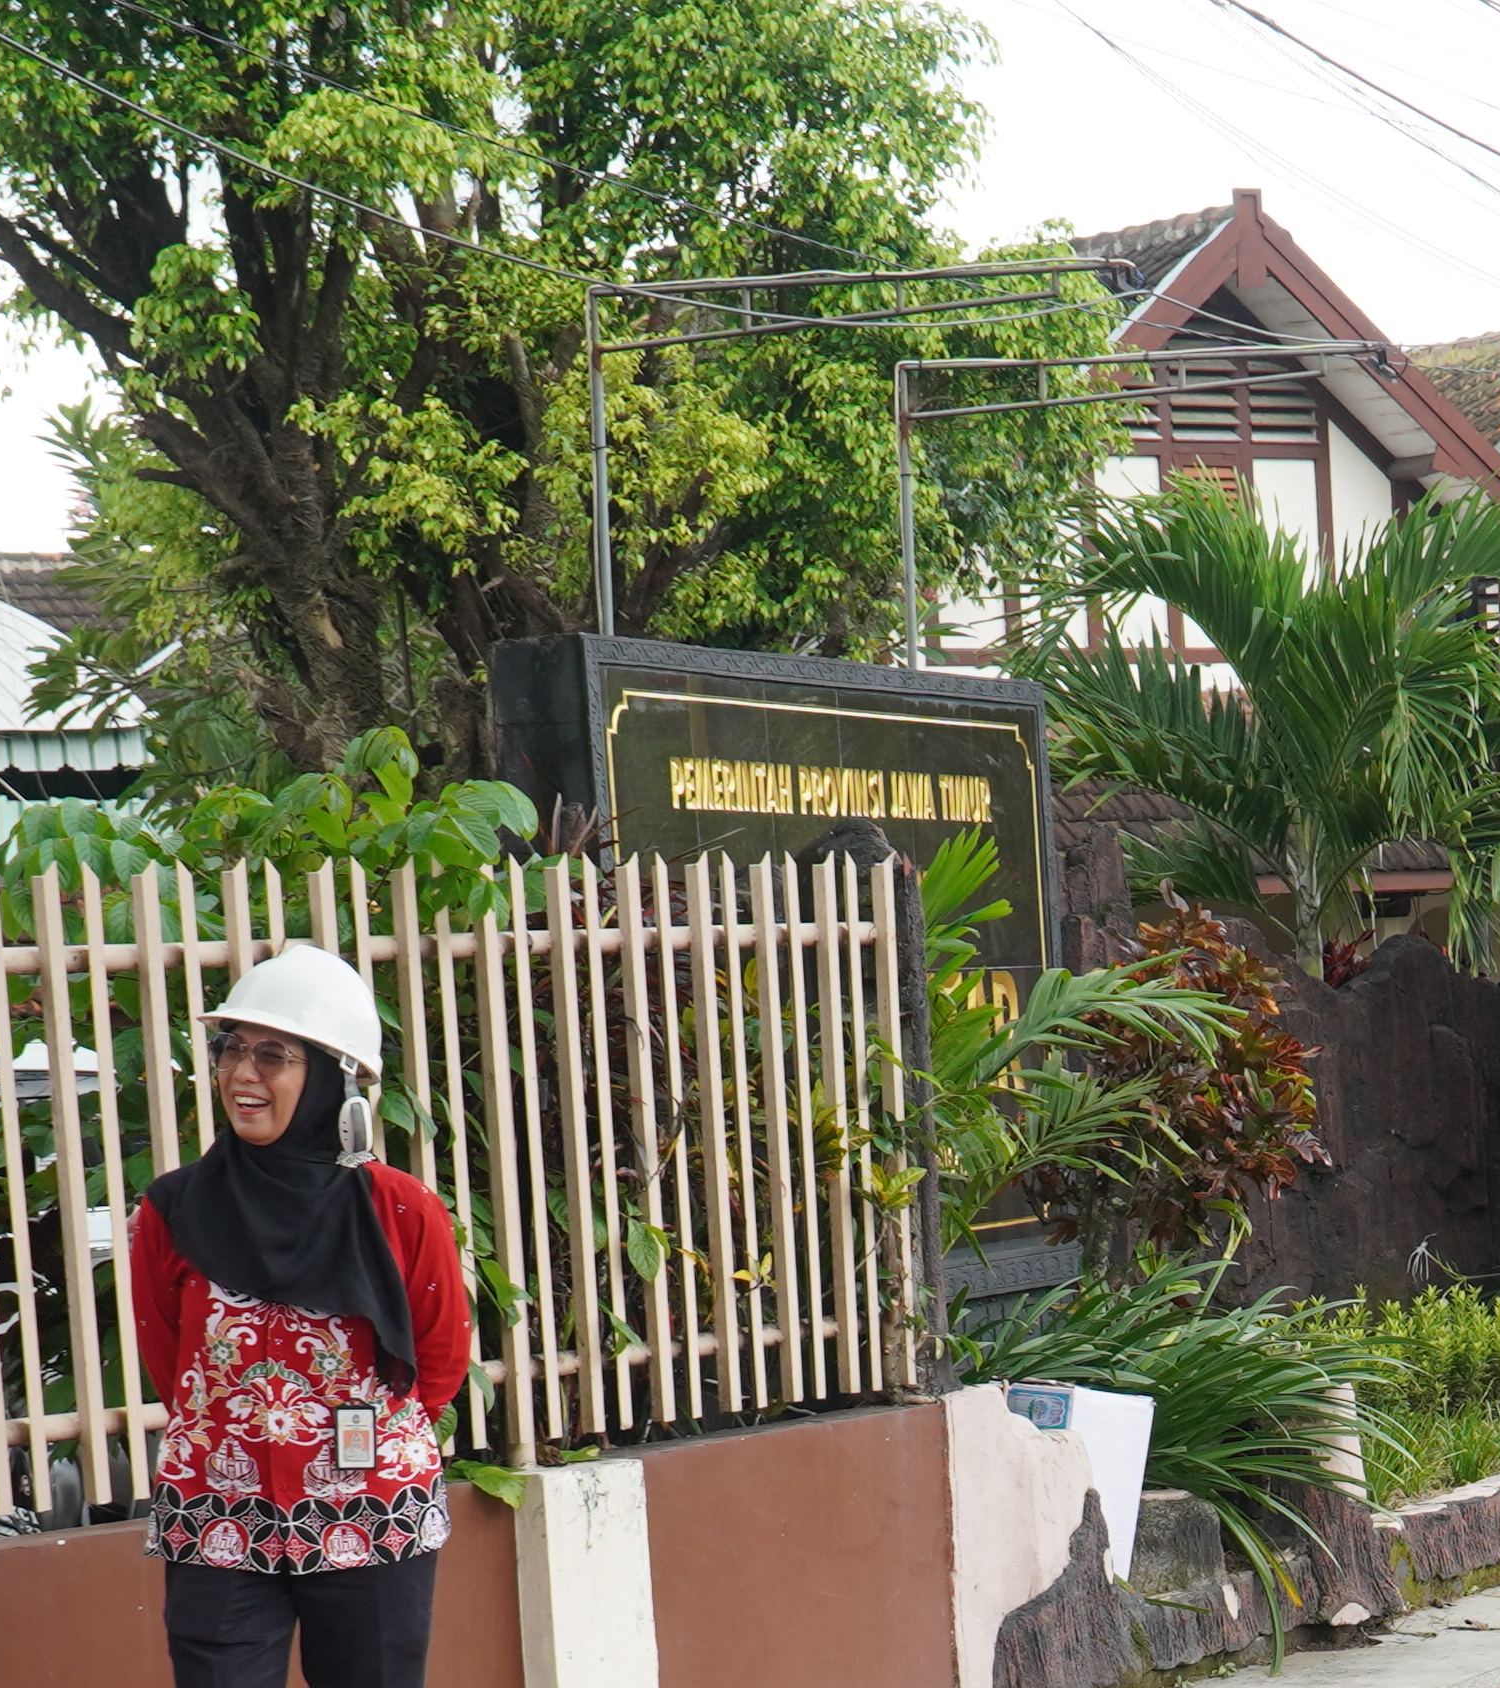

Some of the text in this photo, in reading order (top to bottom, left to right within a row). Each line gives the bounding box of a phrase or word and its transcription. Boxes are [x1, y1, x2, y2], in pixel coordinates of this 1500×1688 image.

[669, 756, 993, 823] PEMERINTAH PROVINSI JAWA TIMUR
